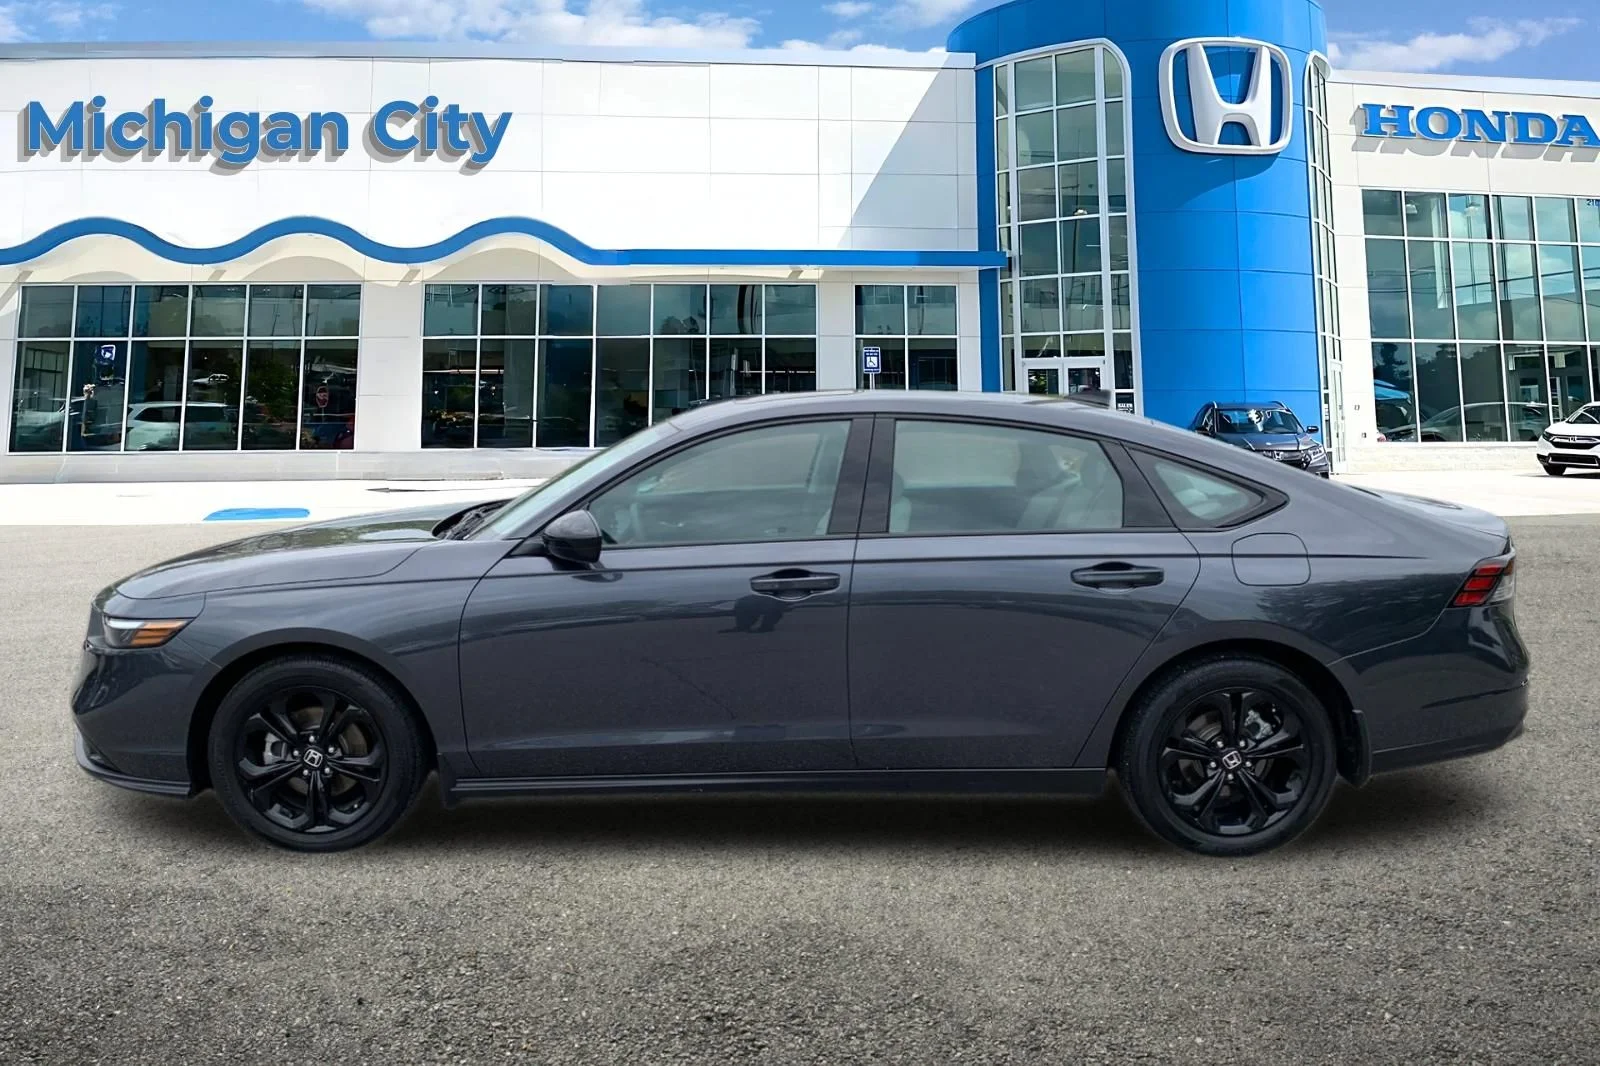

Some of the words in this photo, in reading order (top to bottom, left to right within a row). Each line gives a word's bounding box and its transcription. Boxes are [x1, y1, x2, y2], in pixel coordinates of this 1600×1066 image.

[27, 95, 349, 163] Michigan
[373, 95, 513, 163] City
[1361, 102, 1600, 148] HONDA
